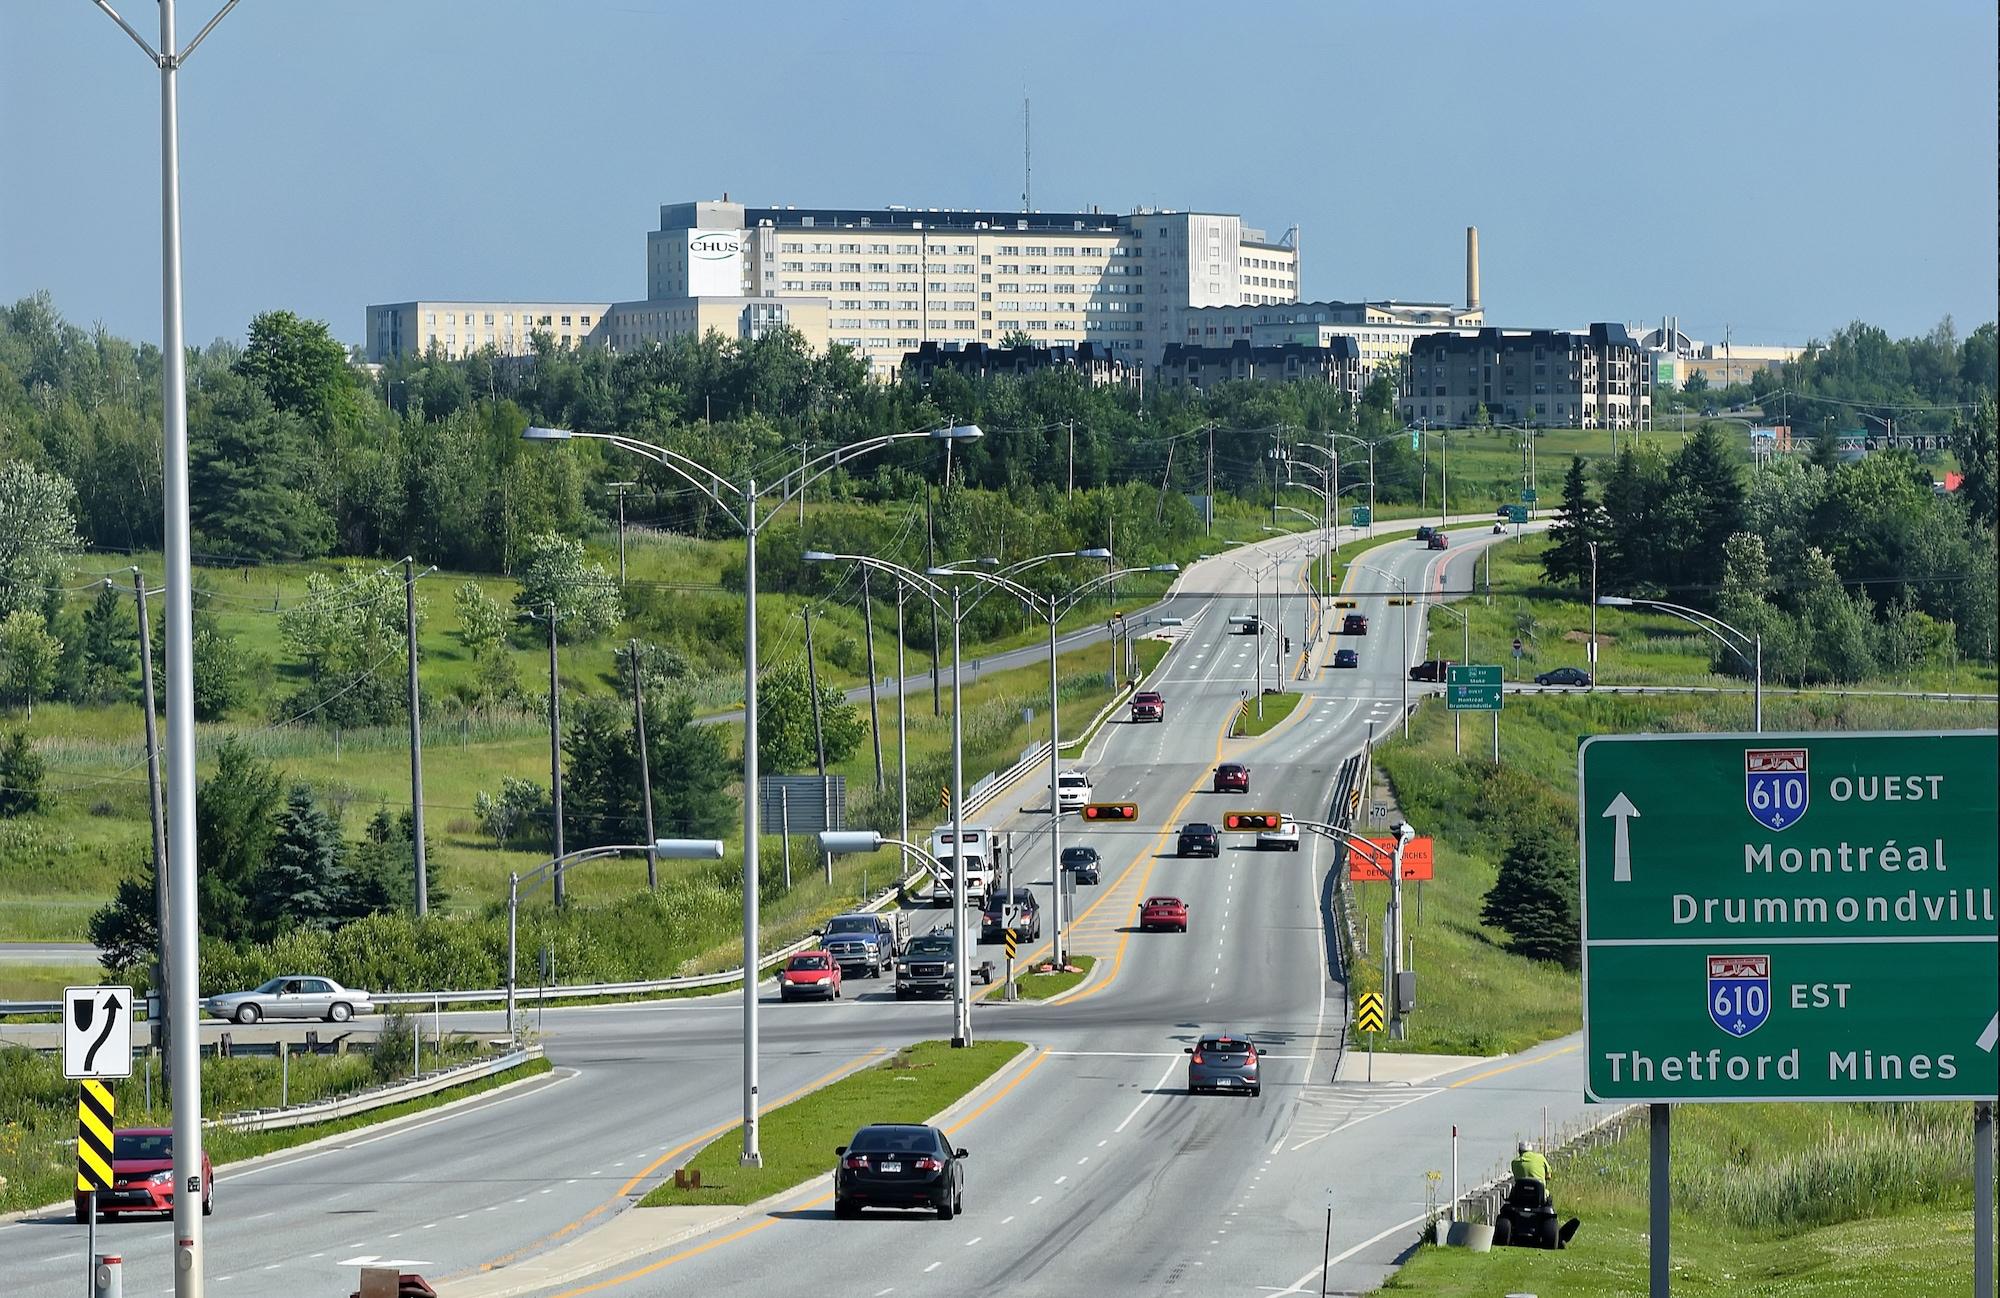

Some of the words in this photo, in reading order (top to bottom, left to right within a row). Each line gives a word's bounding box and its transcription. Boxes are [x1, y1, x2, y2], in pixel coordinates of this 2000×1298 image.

[690, 242, 739, 252] CHUS
[1752, 778, 1803, 810] 610
[1829, 775, 1944, 802] OUEST
[1374, 807, 1386, 817] 70
[1744, 839, 1947, 873] Montréal
[1672, 888, 1995, 924] Drummondvill
[1714, 986, 1764, 1017] 610
[1791, 983, 1851, 1009] EST
[1605, 1048, 1800, 1082] Thetford
[1828, 1050, 1958, 1081] Mines
